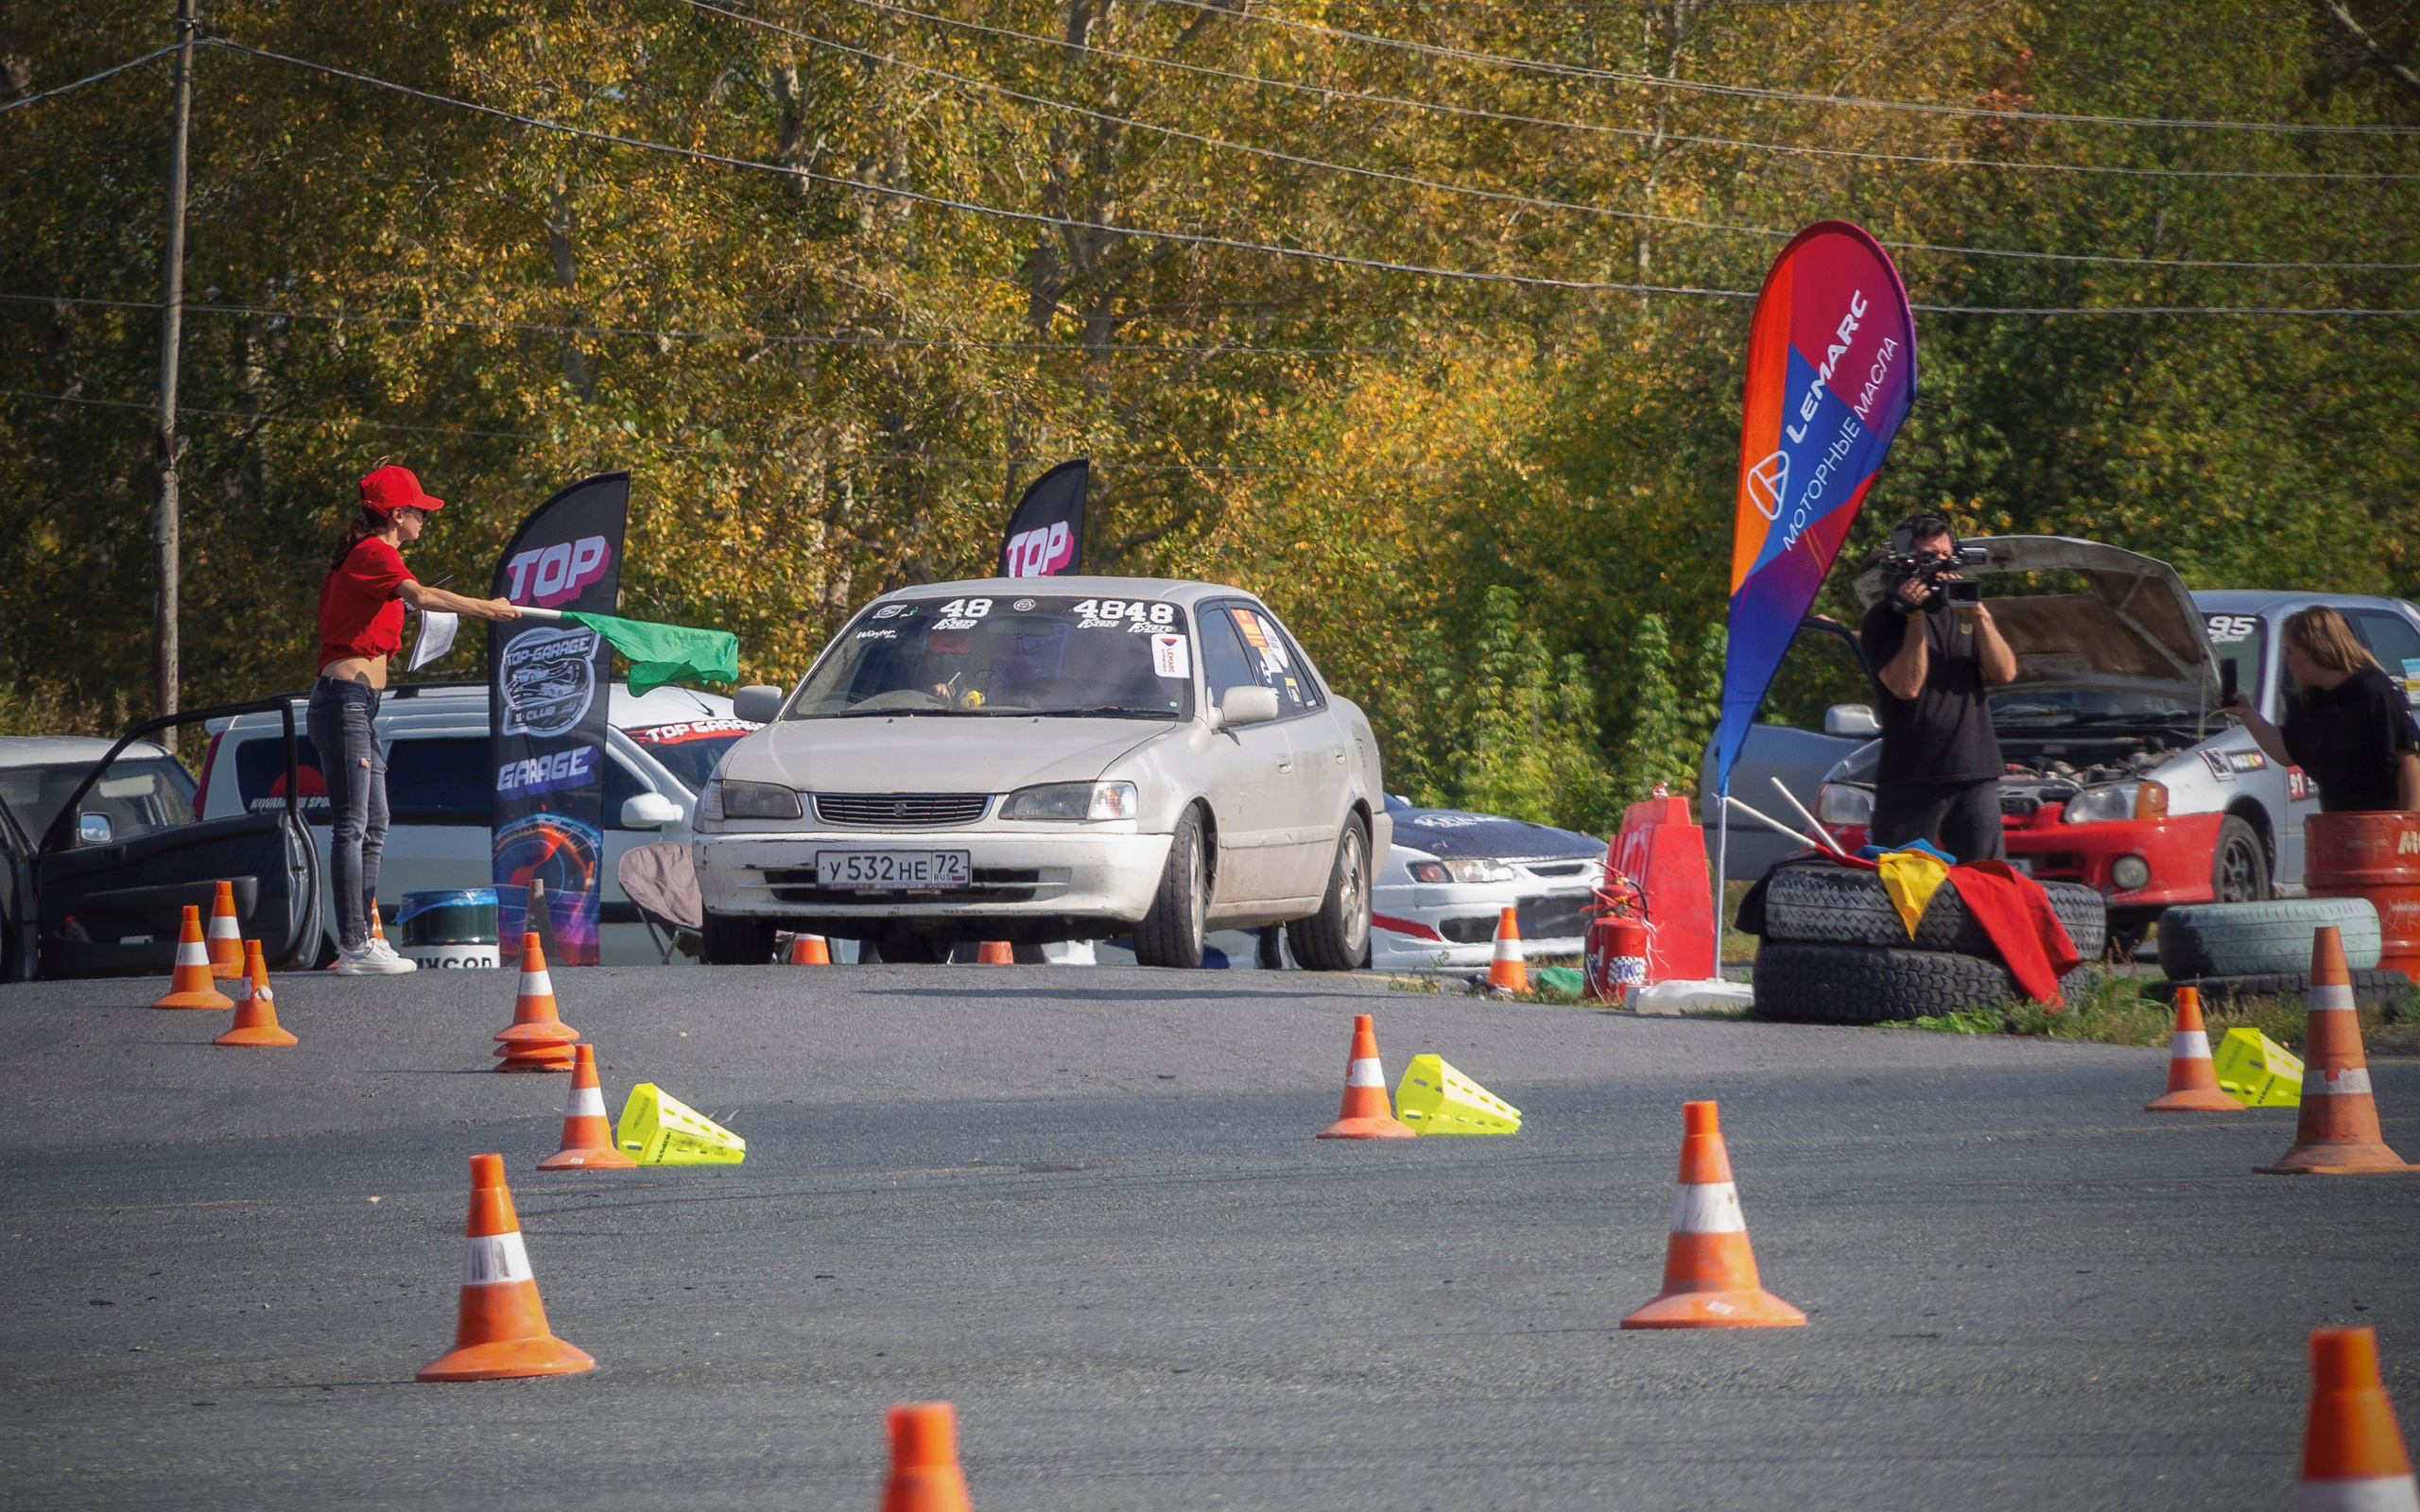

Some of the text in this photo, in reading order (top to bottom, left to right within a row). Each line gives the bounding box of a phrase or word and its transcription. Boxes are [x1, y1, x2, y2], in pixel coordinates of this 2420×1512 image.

[1785, 289, 1869, 444] LEMARC
[1782, 336, 1899, 552] МОТОРНЫЕ МАСЛА
[1006, 521, 1072, 578] TOP
[507, 535, 609, 605] TOP
[940, 598, 994, 618] 48
[1073, 599, 1127, 620] 48
[1124, 602, 1174, 625] 48
[856, 628, 895, 639] Winter
[2207, 615, 2257, 635] 95
[507, 636, 591, 667] TOP-GARAGE
[645, 723, 691, 744] TOP
[497, 745, 597, 796] GARAGE
[2289, 772, 2305, 796] 91
[935, 854, 959, 874] 72
[933, 873, 951, 882] RUS
